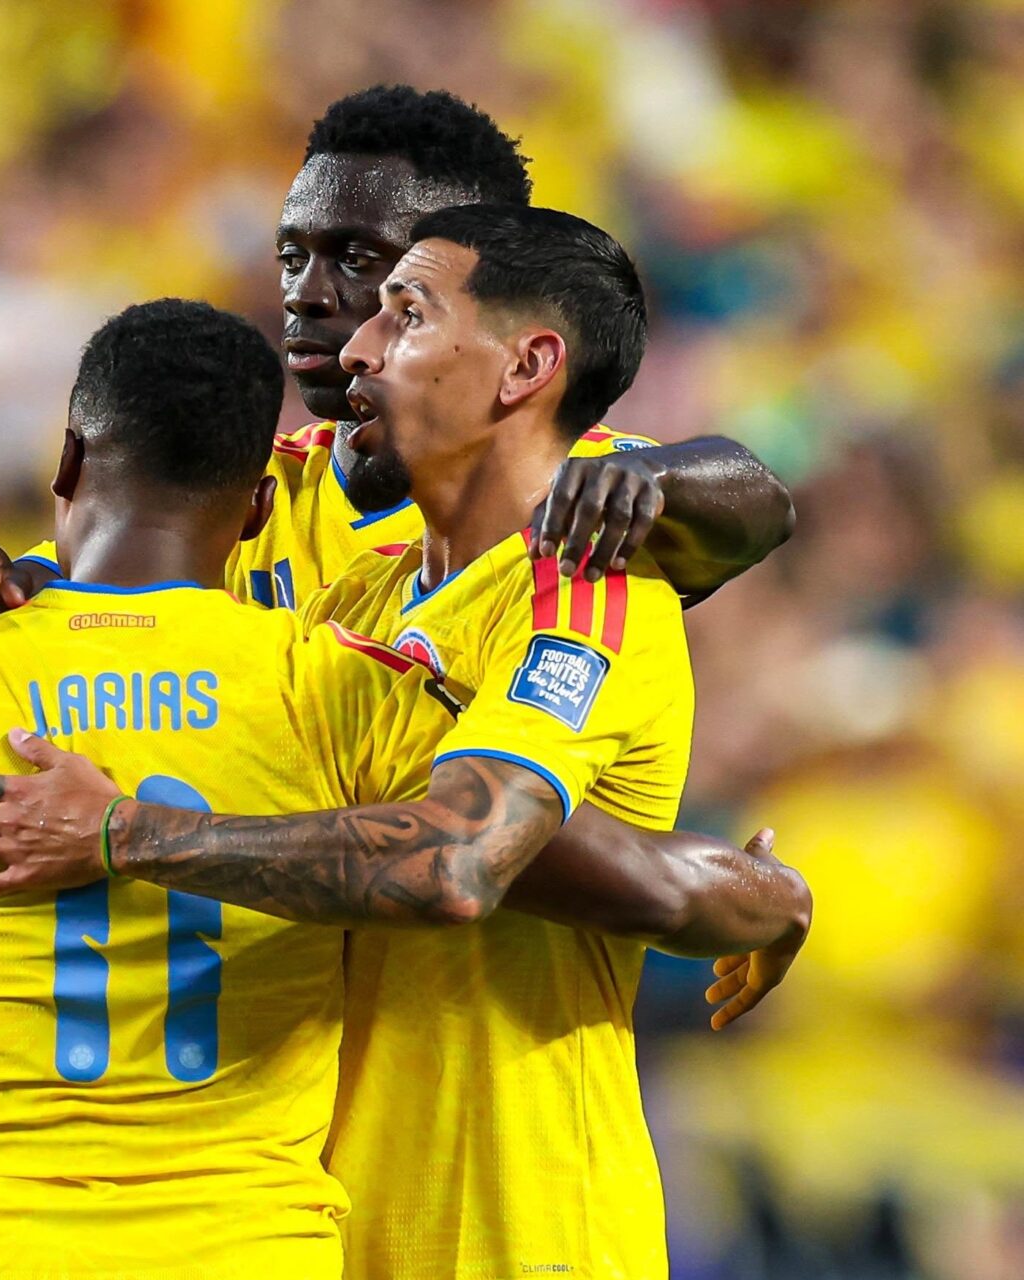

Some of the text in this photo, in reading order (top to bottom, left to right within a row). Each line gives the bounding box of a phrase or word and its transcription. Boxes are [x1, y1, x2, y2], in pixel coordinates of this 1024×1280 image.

[69, 613, 155, 630] COLOMBIA
[536, 660, 589, 692] UNITES
[540, 648, 592, 678] FOOTBALL
[28, 670, 219, 738] J.ARIAS
[527, 669, 584, 708] the World
